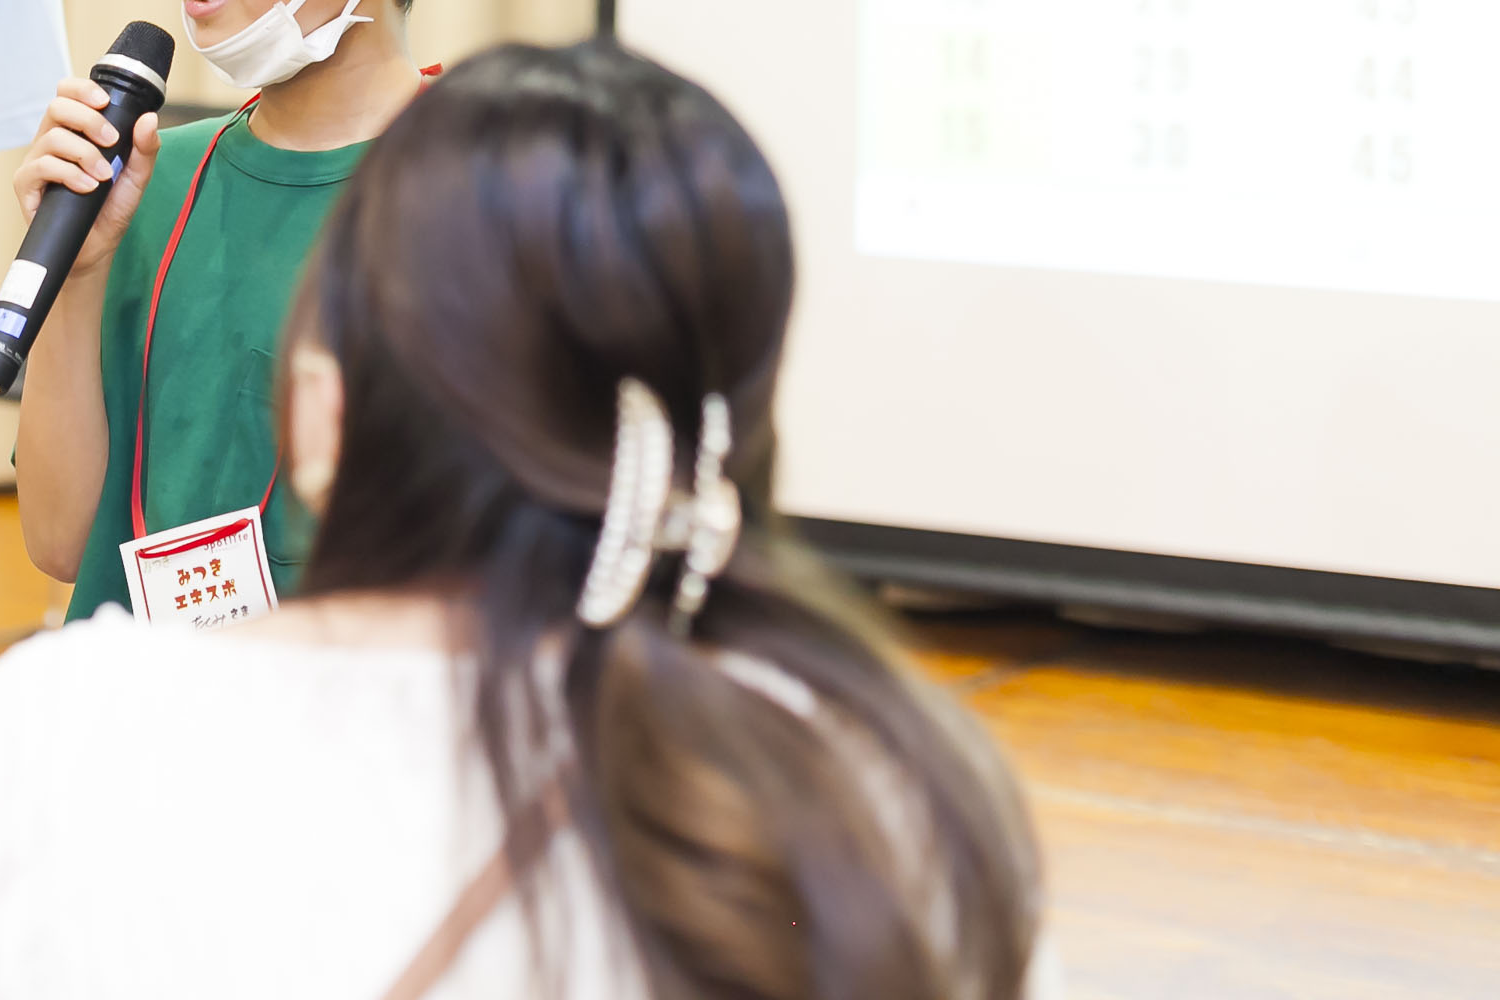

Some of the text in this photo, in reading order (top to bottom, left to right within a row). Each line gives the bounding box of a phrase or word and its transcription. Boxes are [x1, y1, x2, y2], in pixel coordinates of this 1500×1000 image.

[1354, 55, 1417, 105] 44
[1351, 132, 1417, 188] 45
[177, 558, 221, 586] みつき
[174, 578, 237, 610] エキスポ
